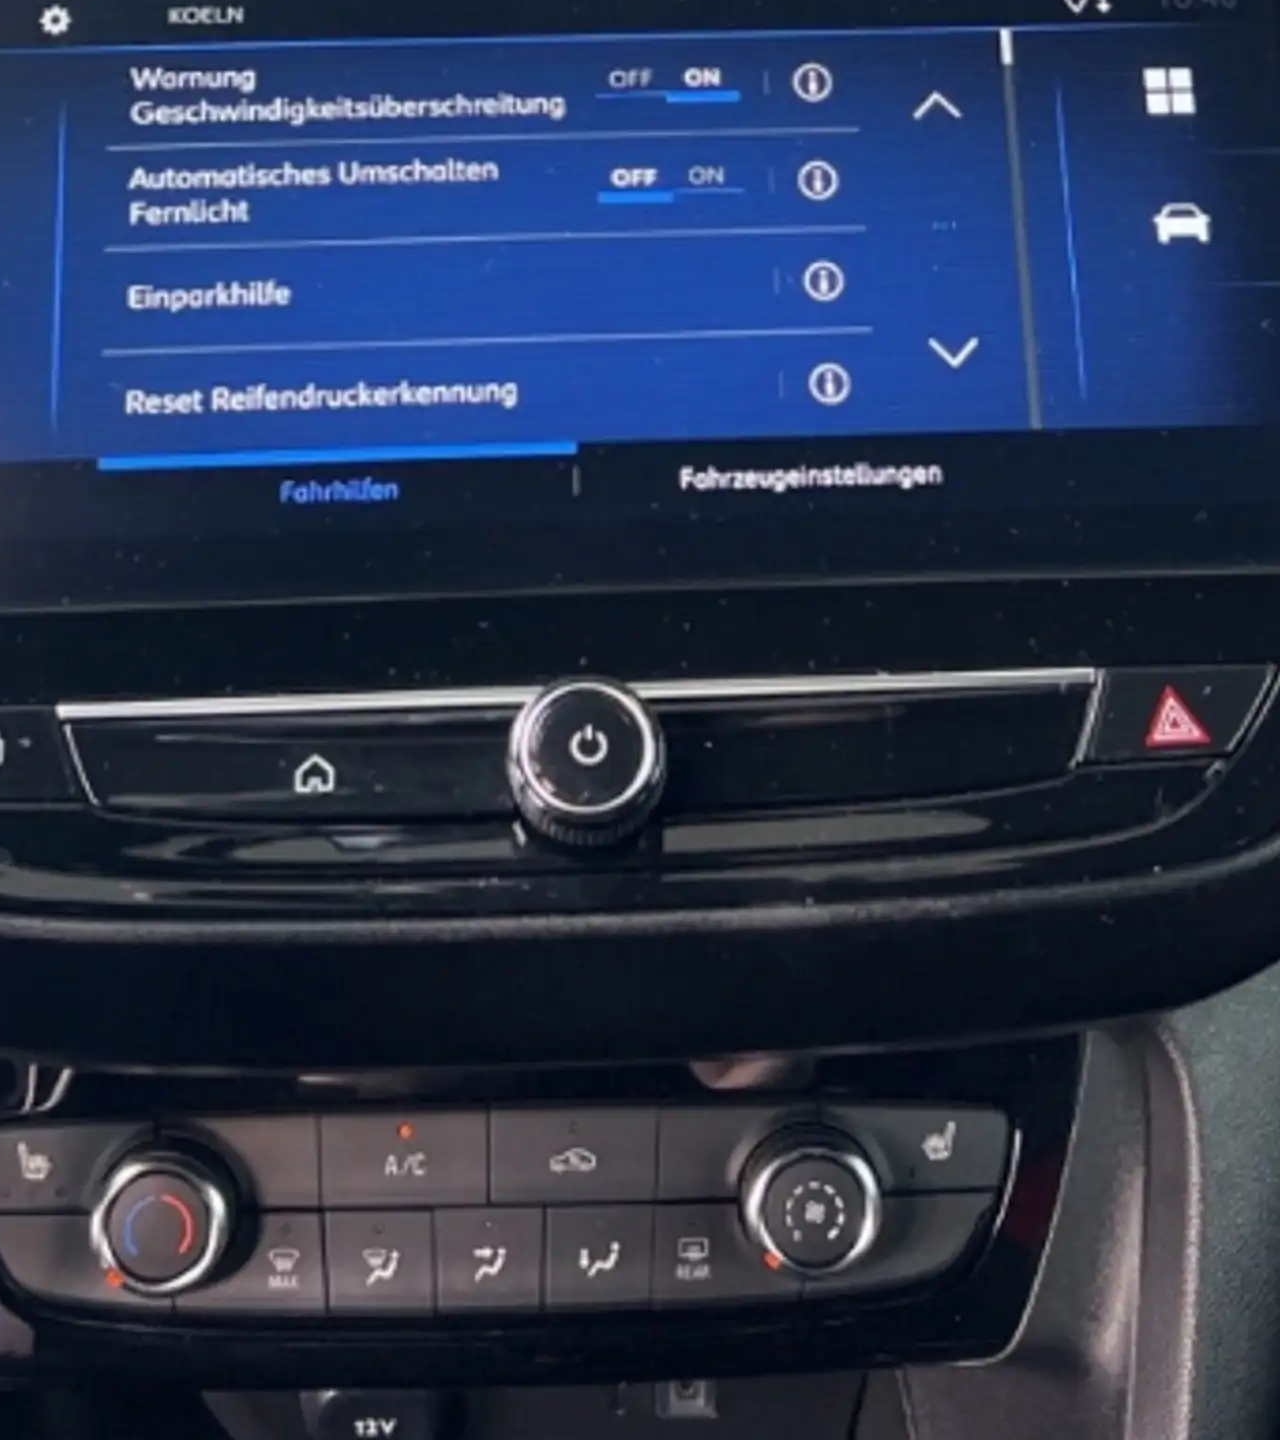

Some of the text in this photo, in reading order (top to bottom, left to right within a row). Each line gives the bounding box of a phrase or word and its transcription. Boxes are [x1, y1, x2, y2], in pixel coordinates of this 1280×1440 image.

[167, 5, 245, 25] KOELN
[130, 67, 256, 93] Warnung
[609, 67, 652, 89] OFF
[684, 67, 721, 87] ON
[130, 91, 566, 126] Geschwindigkeitsüberschreitung
[128, 160, 499, 191] Automatisches Umschalten
[610, 167, 658, 188] OFF
[688, 165, 724, 185] ON
[130, 200, 250, 225] Fernlicht
[127, 279, 292, 312] Einparkhilfe
[125, 380, 518, 414] Reset Reifendruckerkennung
[679, 462, 944, 493] Fahrzeugeinstellungen
[280, 477, 399, 504] Fahrhilfen
[384, 1152, 428, 1177] A/C
[354, 1417, 397, 1437] 12V
